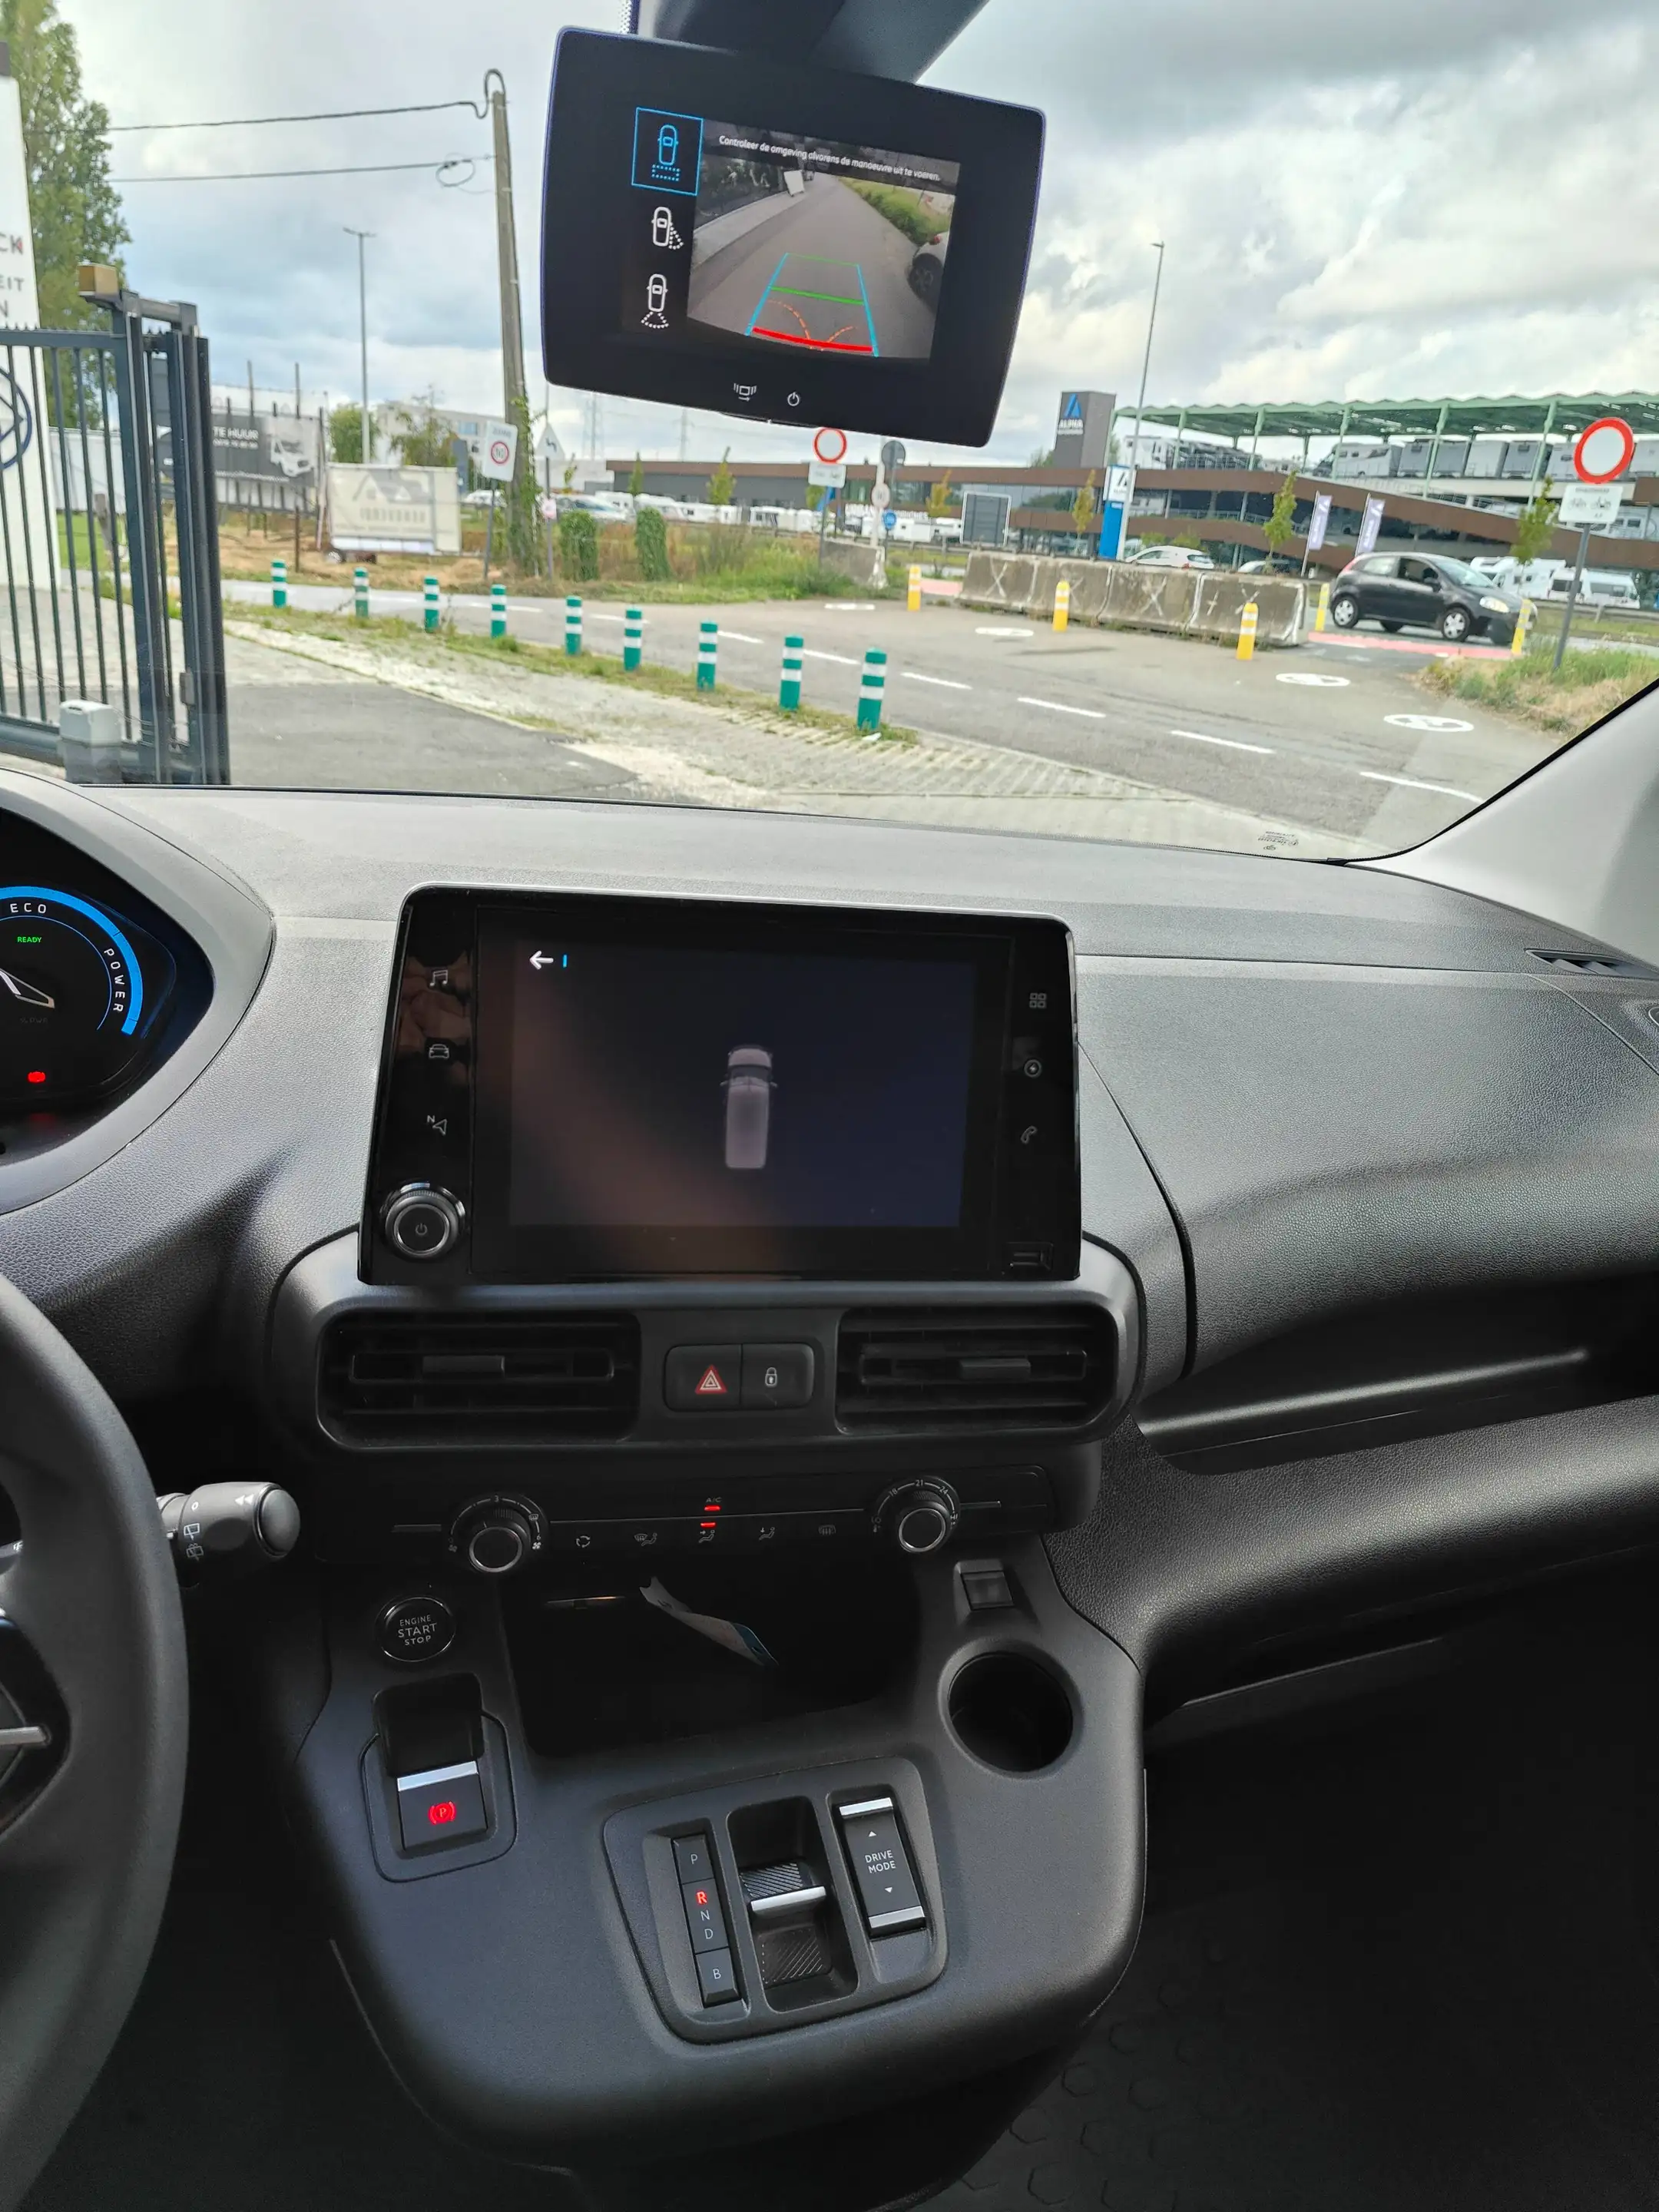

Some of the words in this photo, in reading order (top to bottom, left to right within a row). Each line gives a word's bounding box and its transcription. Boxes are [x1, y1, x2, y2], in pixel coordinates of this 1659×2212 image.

[719, 135, 759, 150] Controleer
[760, 142, 770, 152] de
[770, 145, 808, 160] omgeving
[808, 151, 839, 164] alvorens
[840, 157, 850, 165] de
[851, 159, 892, 173] manoeuvre
[213, 426, 227, 438] TE
[227, 428, 259, 440] HUUR
[10, 902, 47, 914] ECO
[104, 948, 126, 1012] POWER
[939, 1485, 949, 1495] 24
[399, 1614, 432, 1627] ENGINE
[398, 1622, 437, 1637] START
[405, 1635, 432, 1645] STOP
[439, 1807, 447, 1818] P
[690, 1853, 698, 1865] P
[865, 1849, 893, 1863] DRIVE
[868, 1860, 896, 1874] MODE
[697, 1891, 707, 1904] R
[700, 1909, 710, 1921] N
[704, 1929, 714, 1939] D
[713, 1968, 721, 1979] B
